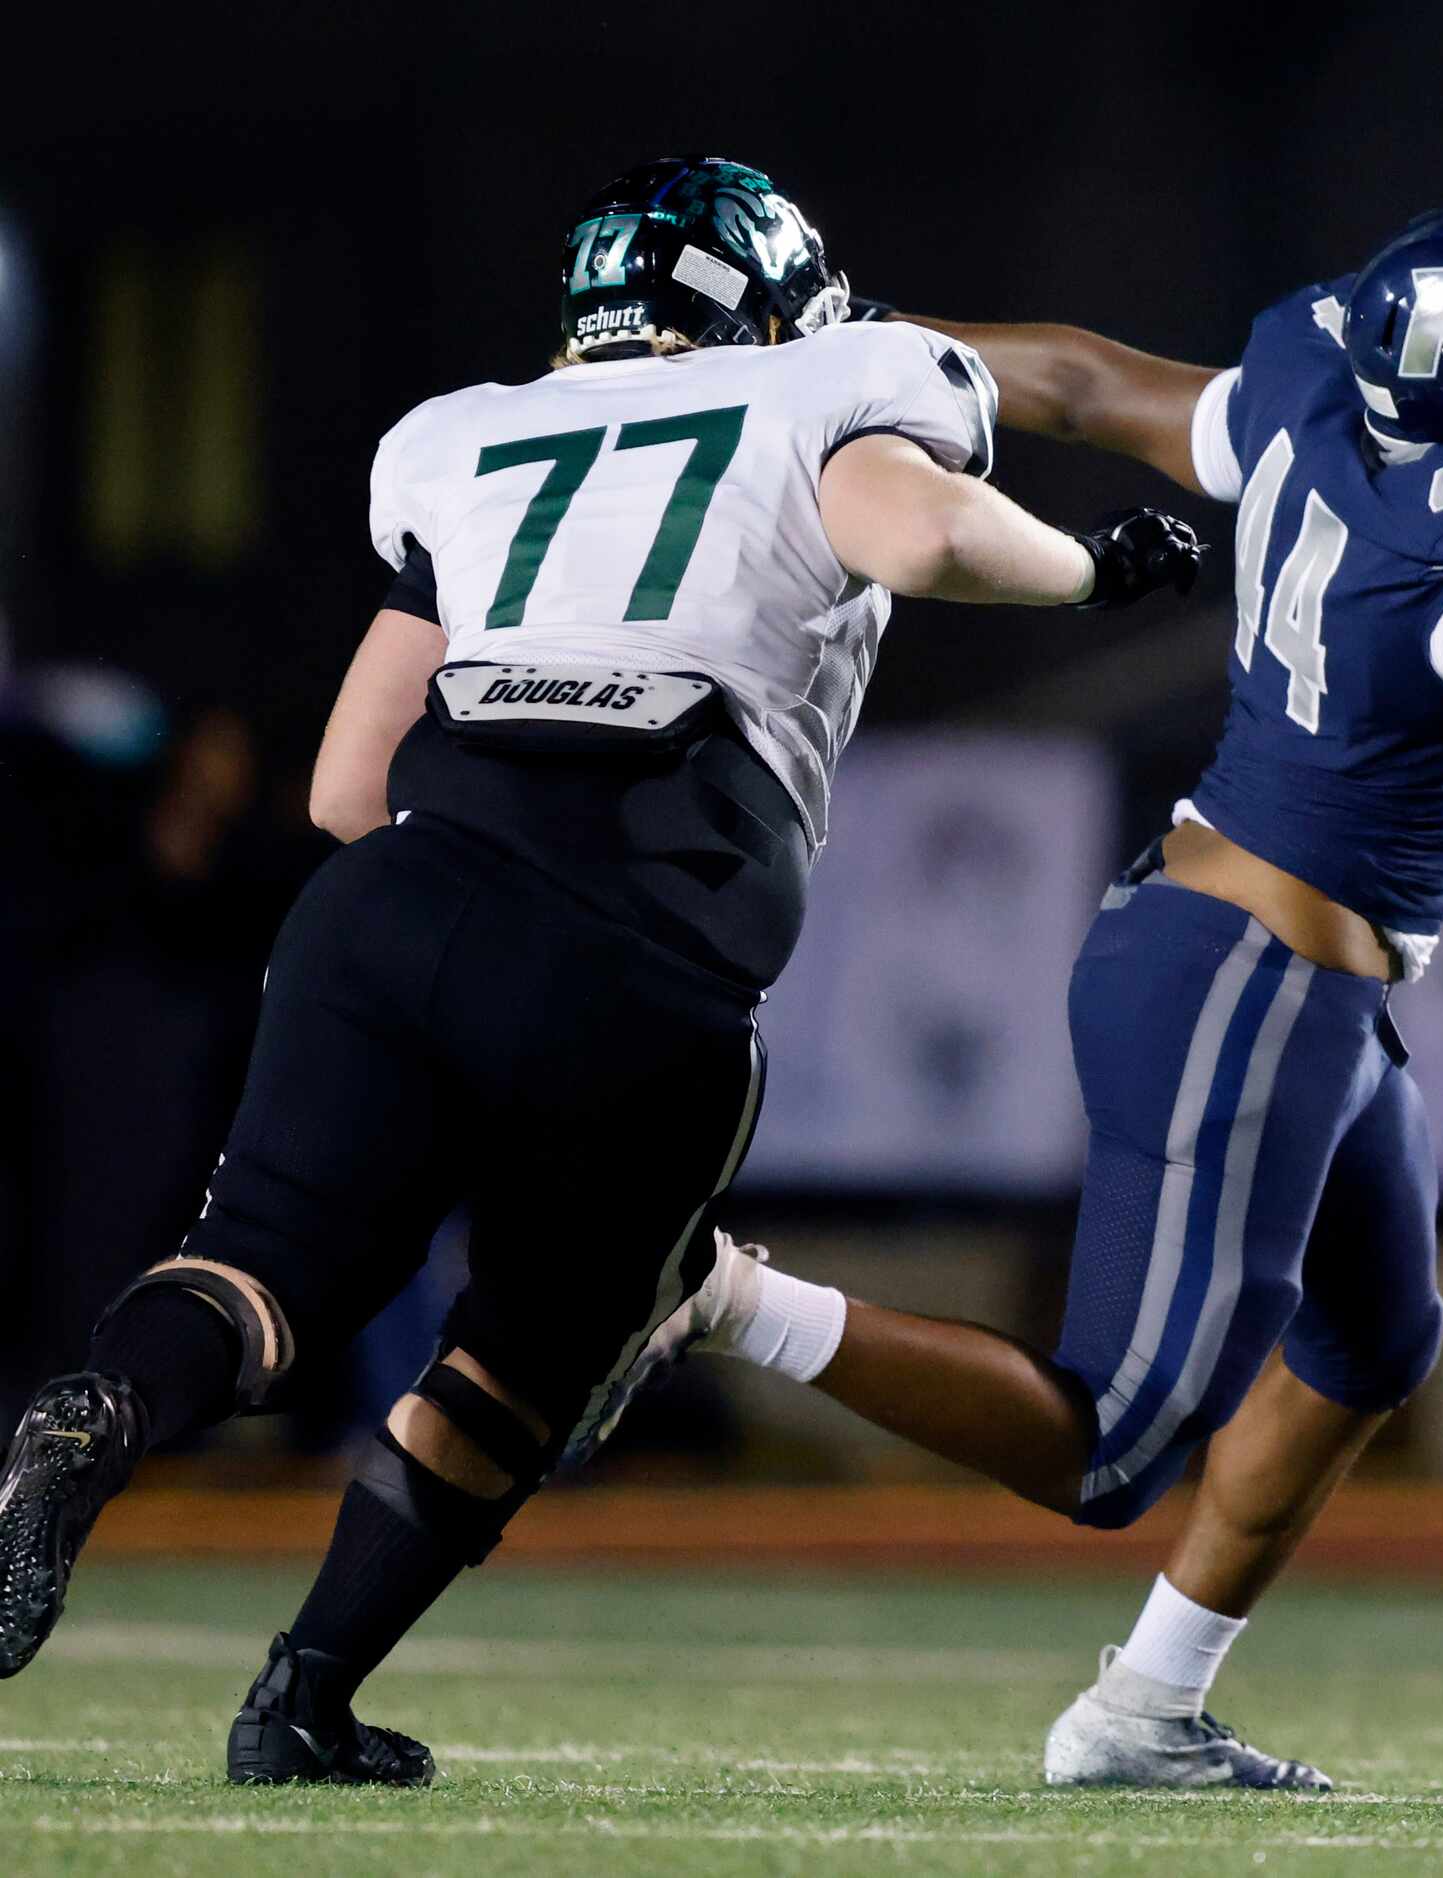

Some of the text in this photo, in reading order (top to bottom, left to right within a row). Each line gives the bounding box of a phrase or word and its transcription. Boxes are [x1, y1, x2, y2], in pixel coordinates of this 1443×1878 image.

[567, 213, 642, 295] 77
[577, 305, 645, 337] schutt
[474, 404, 748, 630] 77
[1235, 427, 1349, 735] 44
[478, 679, 645, 710] DOUGLAS
